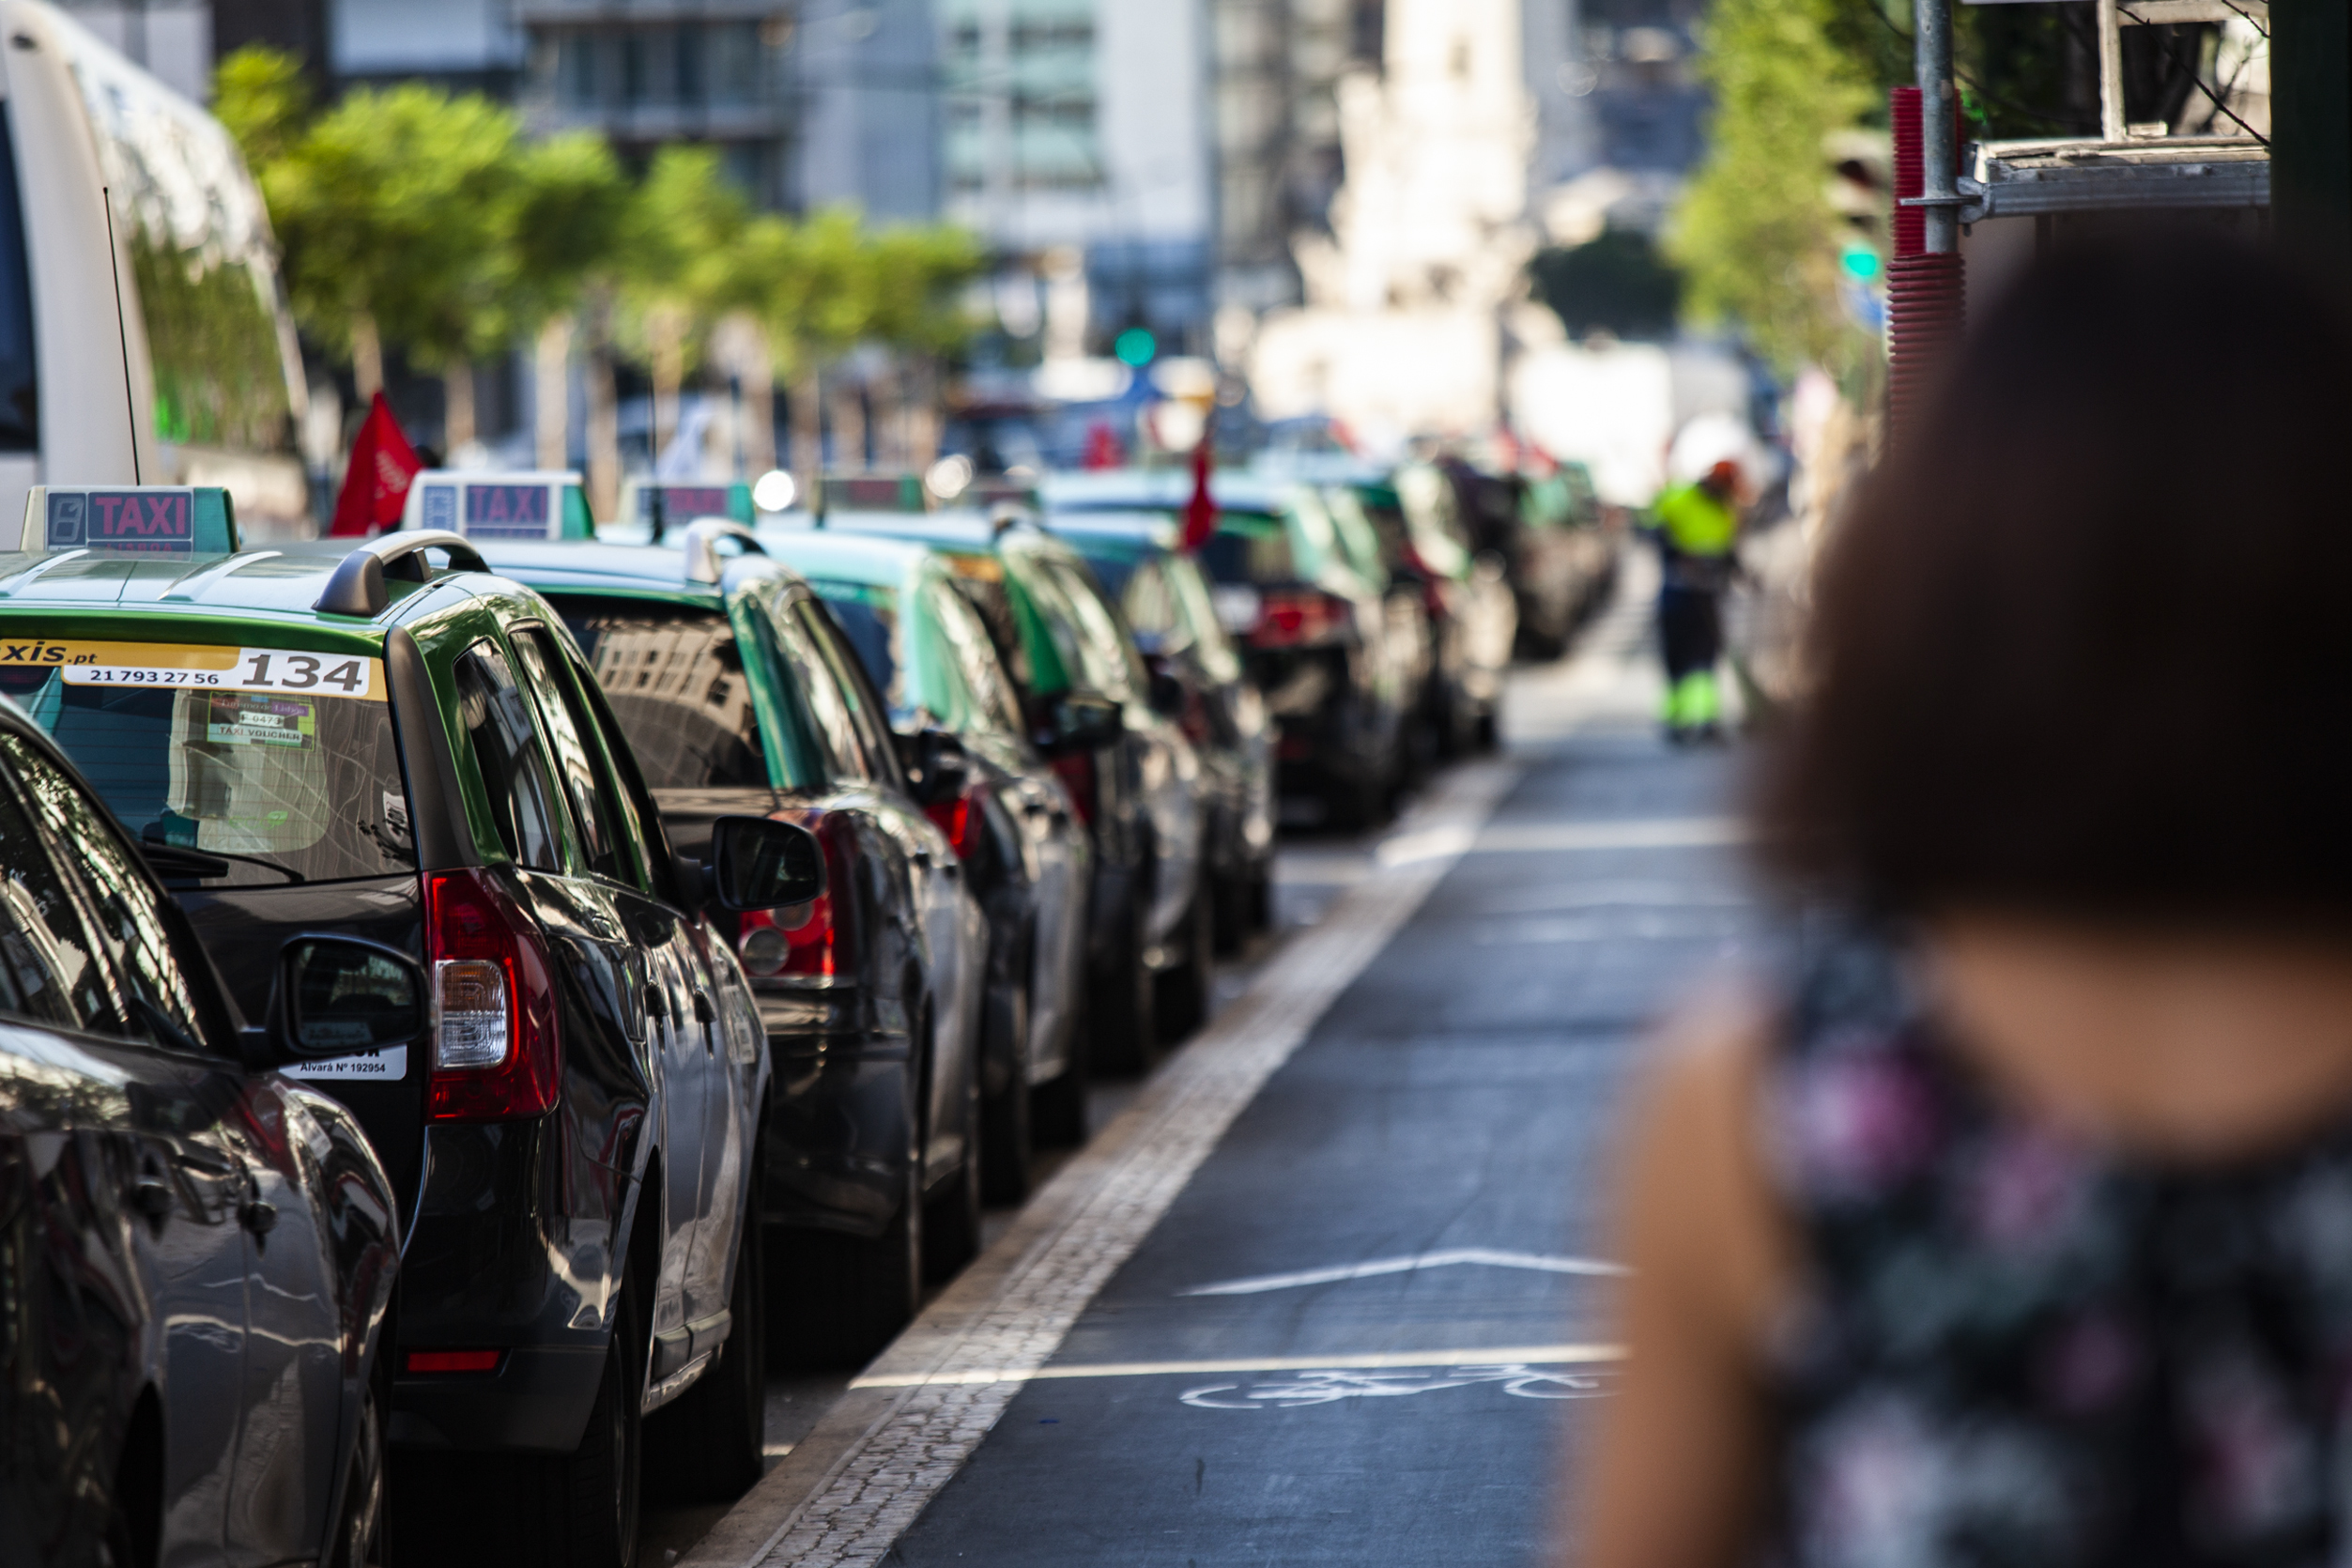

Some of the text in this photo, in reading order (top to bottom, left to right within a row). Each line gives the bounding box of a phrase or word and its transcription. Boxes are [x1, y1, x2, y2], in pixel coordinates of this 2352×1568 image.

[95, 496, 187, 535] TAXI
[469, 485, 548, 522] TAXI
[0, 641, 98, 665] xis.pt
[90, 669, 219, 685] 21 793 27 56
[242, 653, 362, 692] 134
[248, 729, 300, 740] VOUCHER
[300, 1062, 333, 1071] Alvará
[350, 1063, 386, 1072] 192954
